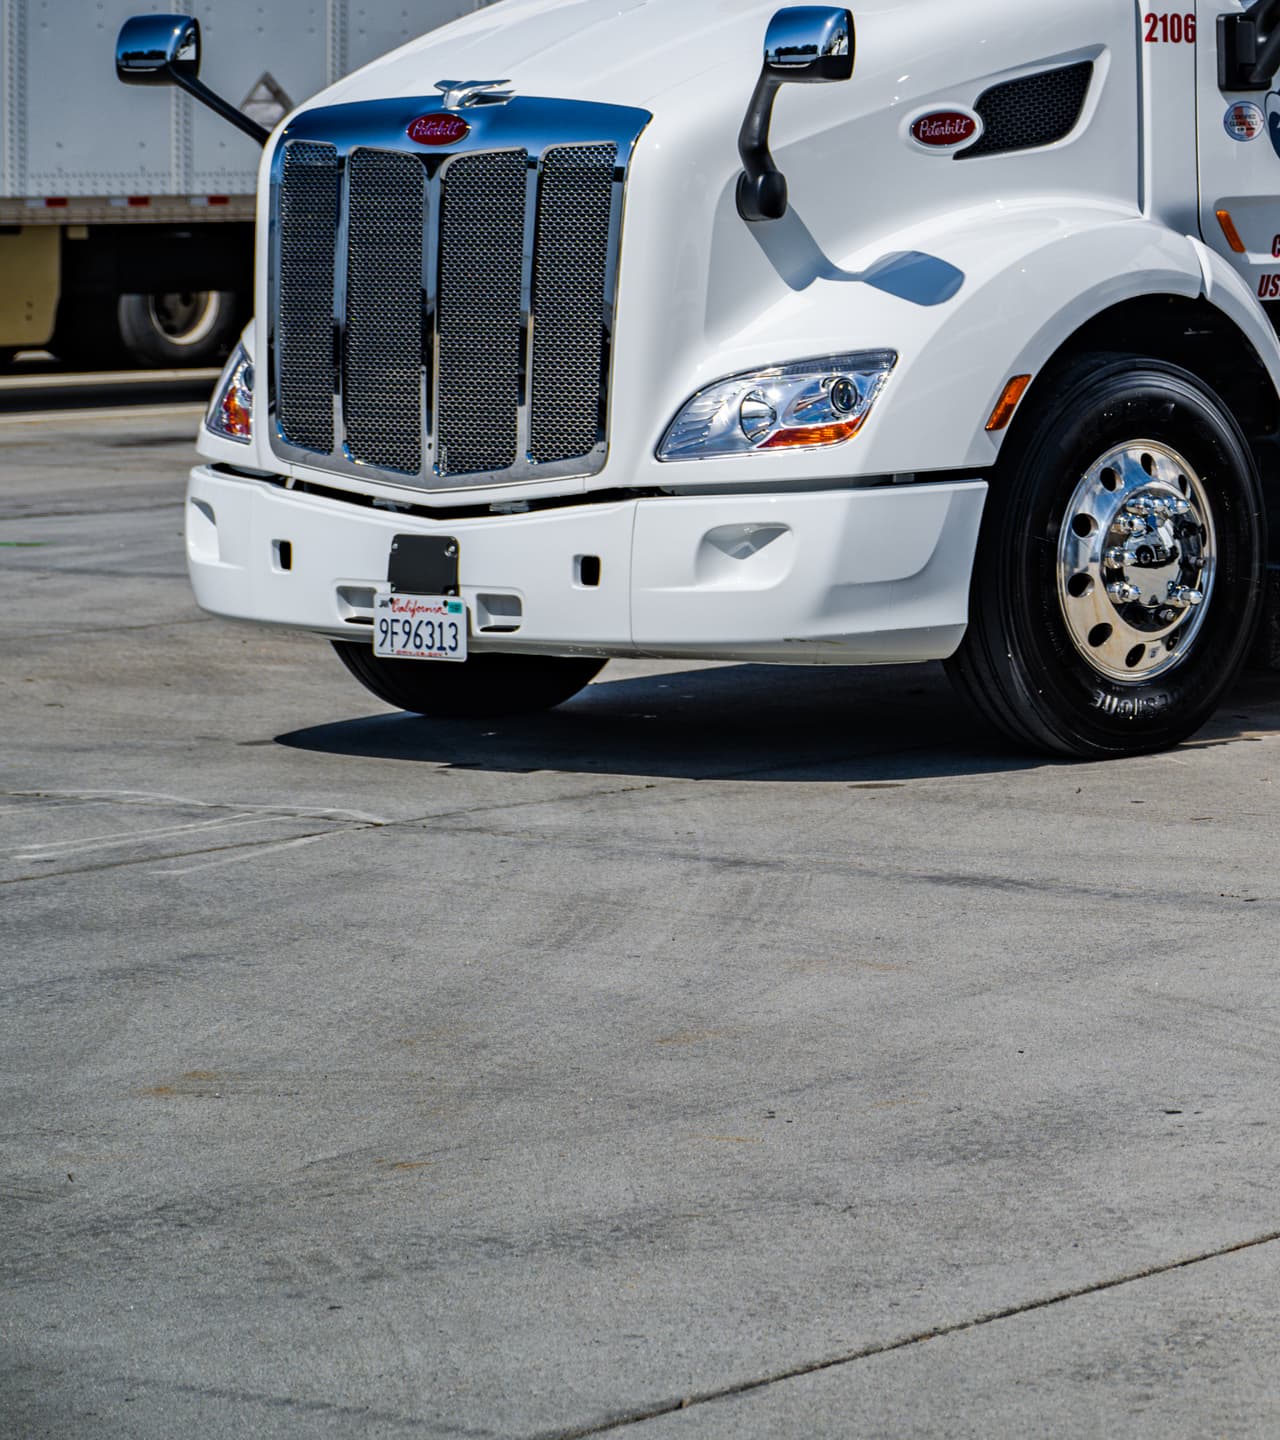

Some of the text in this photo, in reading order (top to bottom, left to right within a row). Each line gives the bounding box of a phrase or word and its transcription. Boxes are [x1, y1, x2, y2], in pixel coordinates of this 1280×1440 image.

[1144, 12, 1196, 44] 2106
[412, 120, 464, 137] Peterbilt
[919, 118, 970, 138] Peterbilt
[391, 598, 448, 618] California
[379, 618, 459, 652] 9F96313
